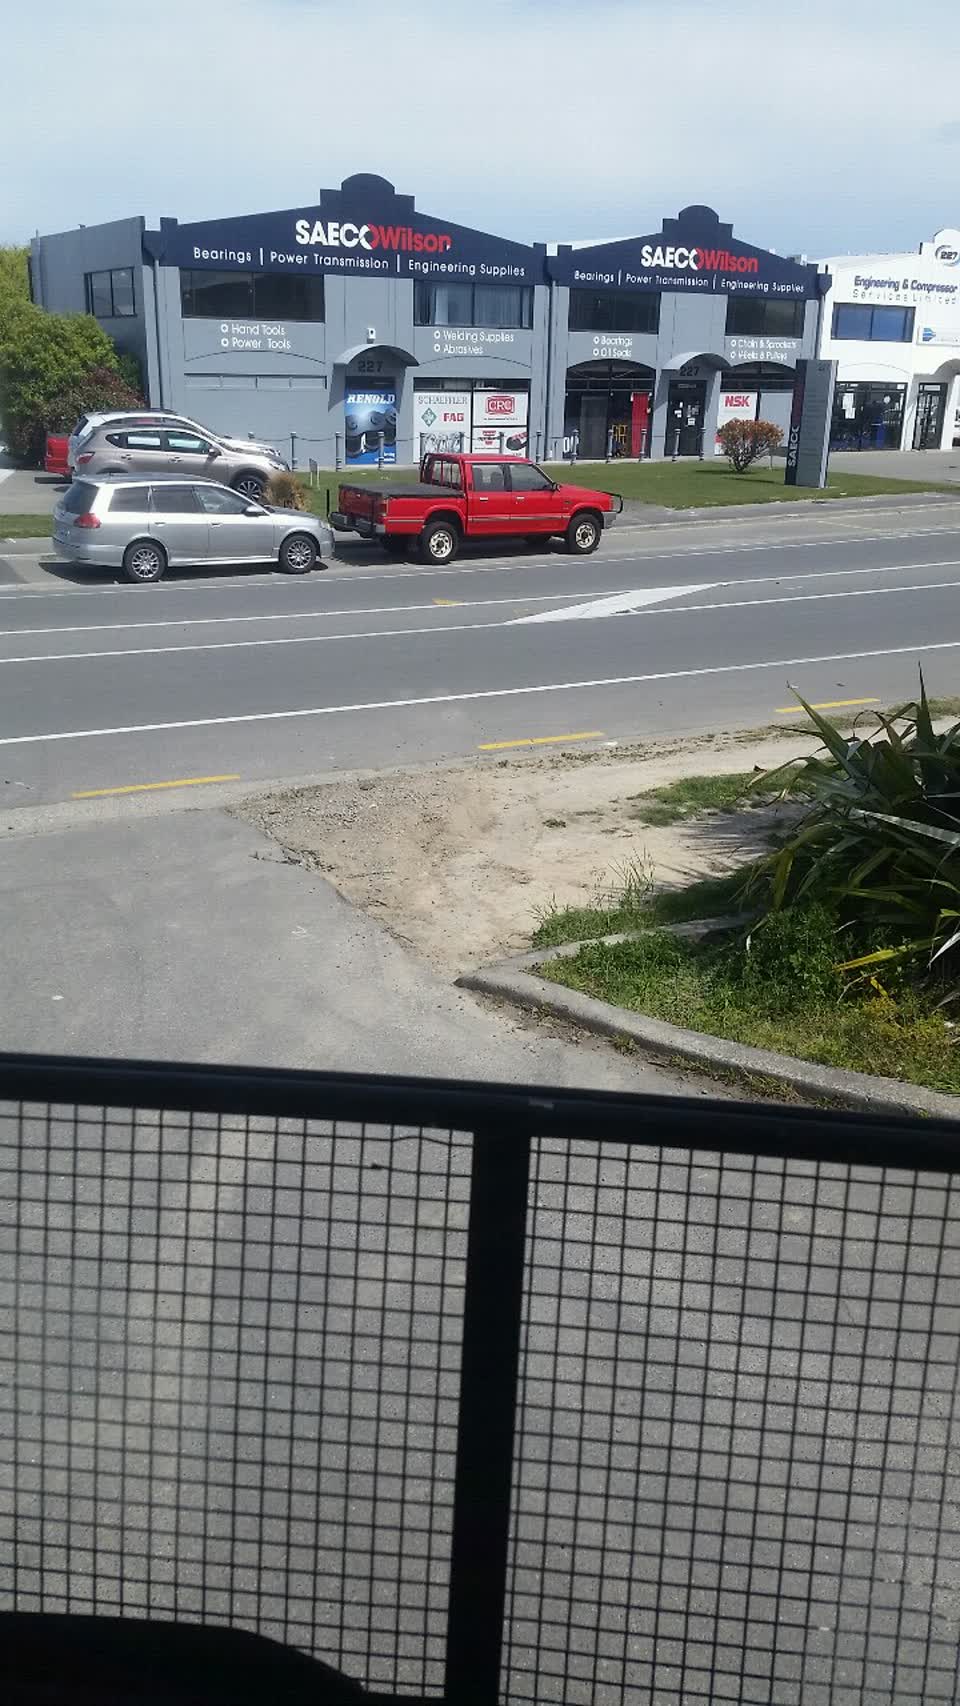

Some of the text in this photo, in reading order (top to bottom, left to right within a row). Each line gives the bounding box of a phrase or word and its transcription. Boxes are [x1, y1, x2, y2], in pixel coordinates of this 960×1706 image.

[193, 247, 525, 277] Bearings Power Transmission Engineering Supplies
[940, 252, 958, 260] 227
[574, 270, 805, 293] Bearings Power Transmission Engineering Supplies
[854, 275, 958, 294] Engineering & Compressor
[231, 323, 286, 335] Hand Tools
[232, 337, 292, 349] Power Tools
[443, 330, 515, 344] Welding Supplies
[443, 344, 484, 355] Abrasives
[357, 360, 383, 373] 227
[680, 366, 700, 377] 227
[346, 394, 396, 404] RENOLD
[724, 396, 751, 407] NSK
[488, 400, 513, 412] CRC
[443, 412, 465, 422] FAG
